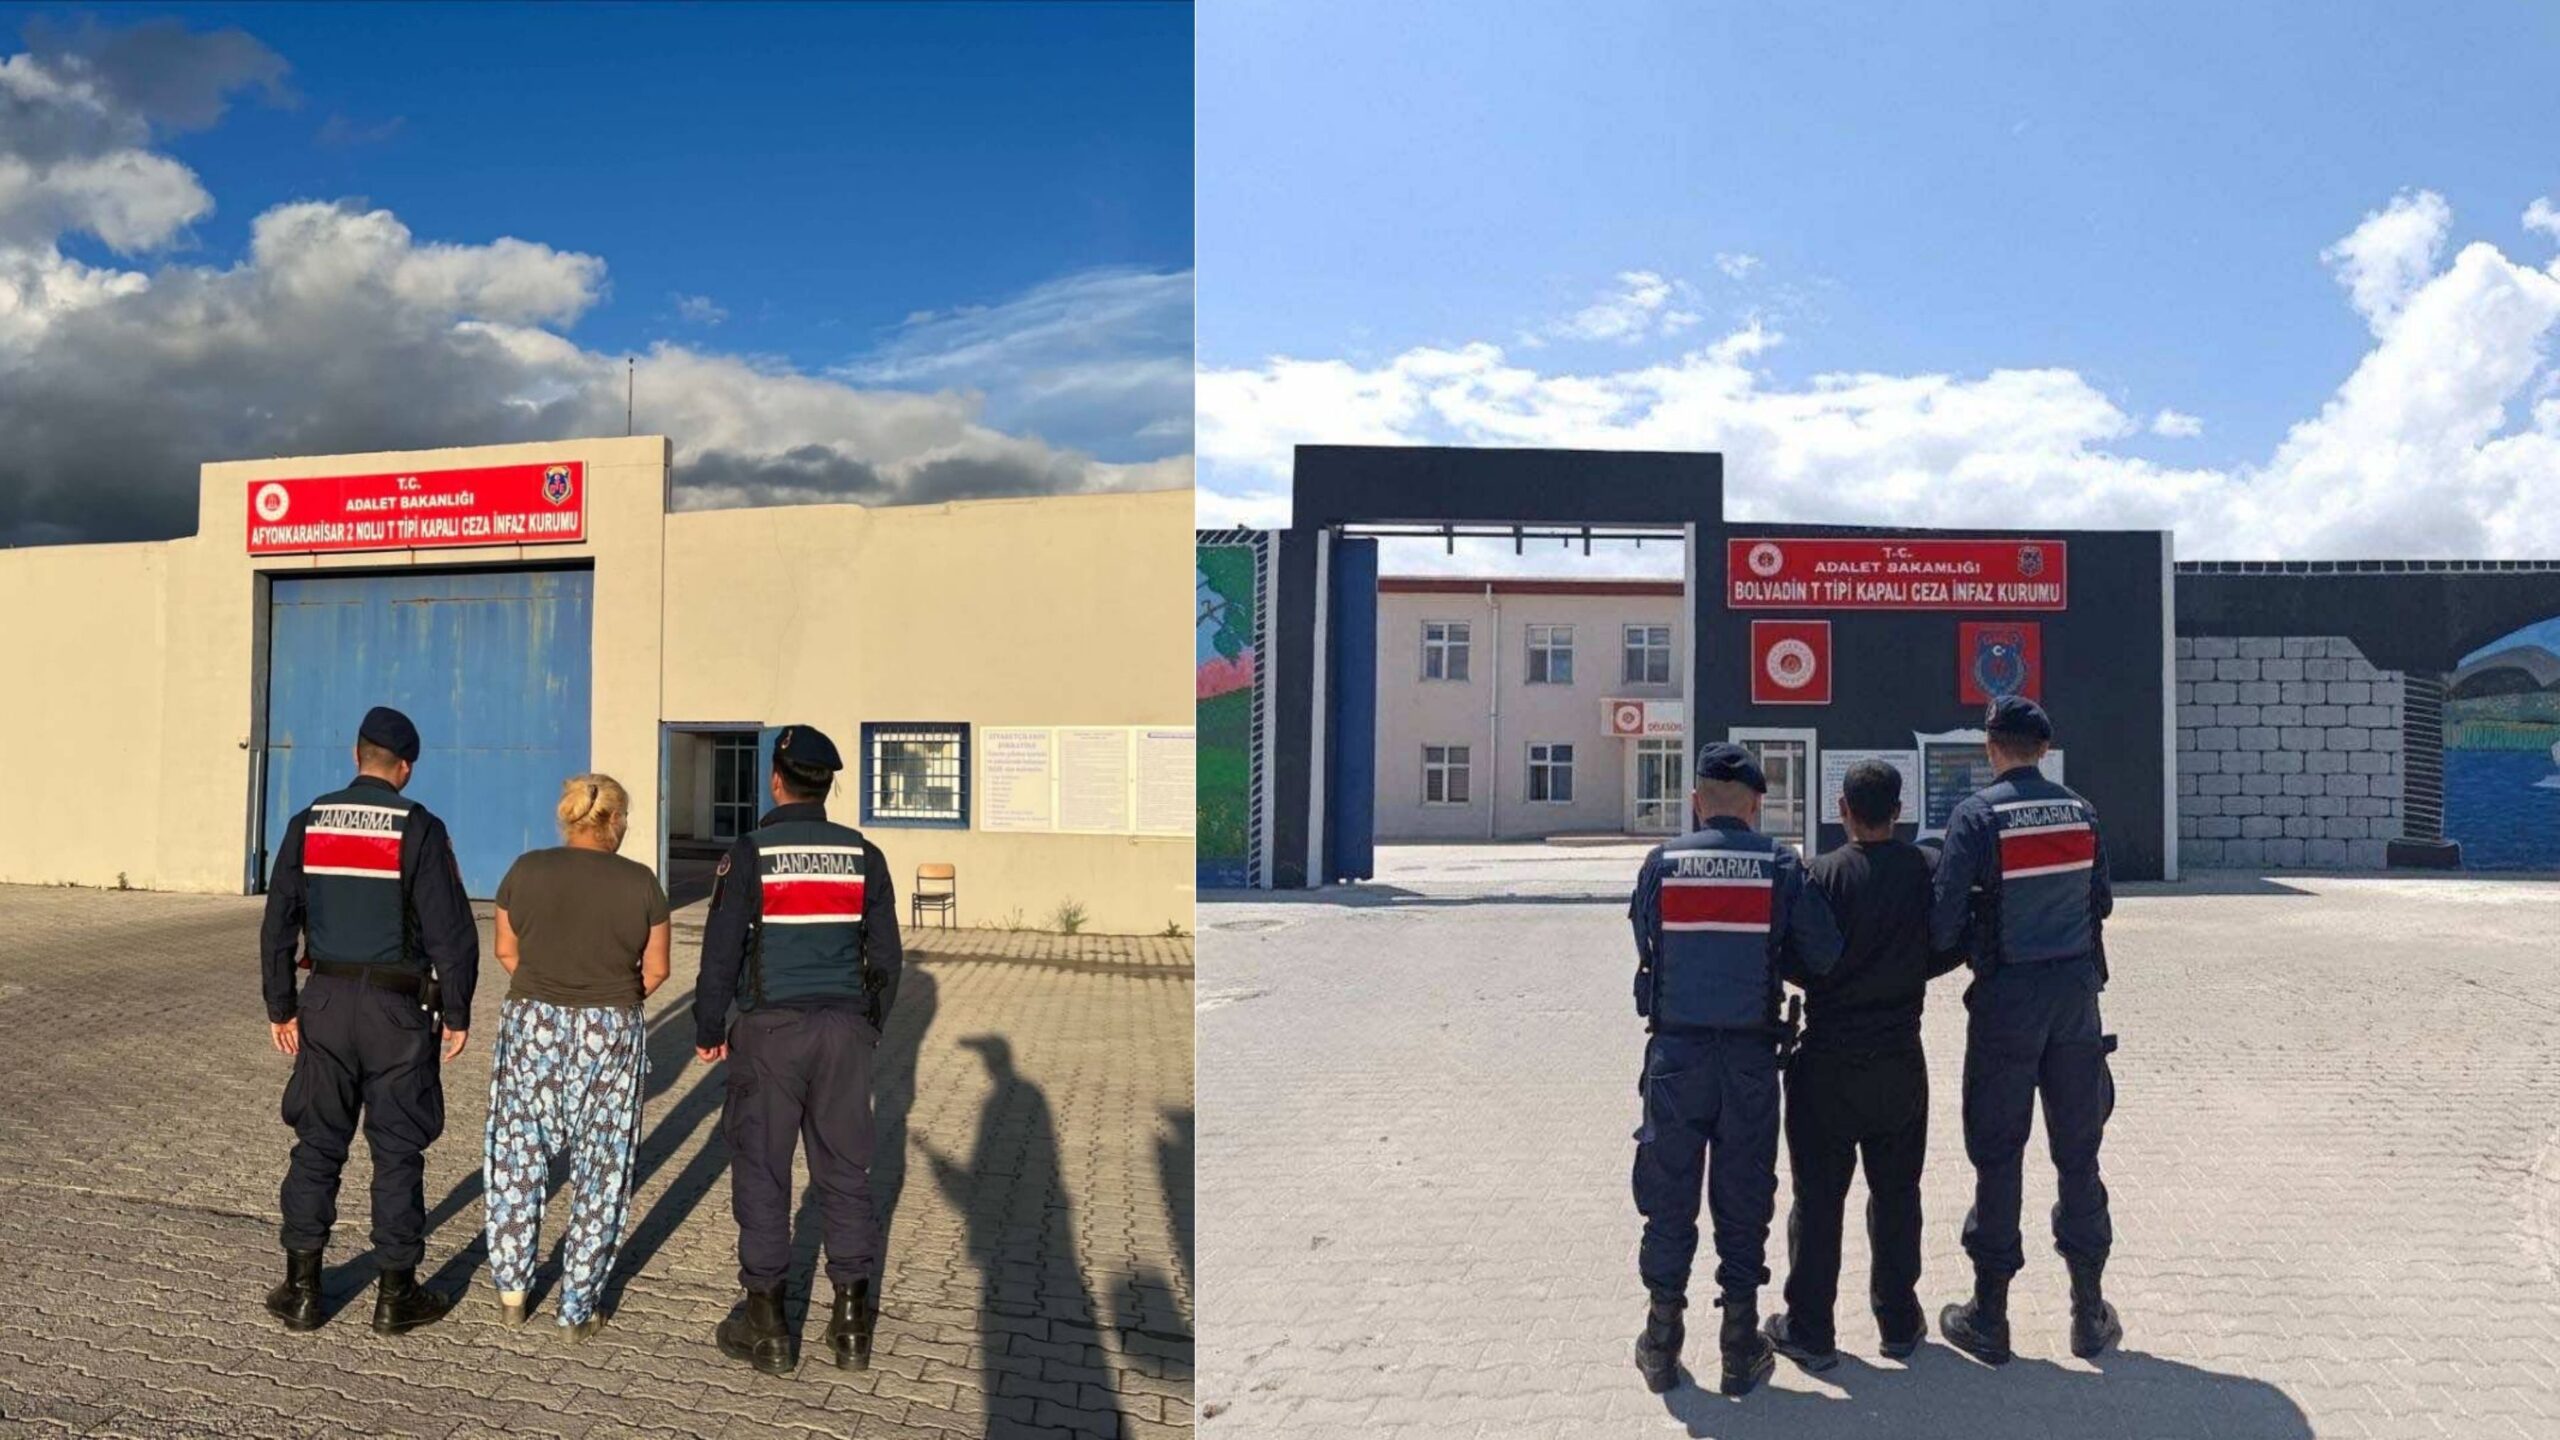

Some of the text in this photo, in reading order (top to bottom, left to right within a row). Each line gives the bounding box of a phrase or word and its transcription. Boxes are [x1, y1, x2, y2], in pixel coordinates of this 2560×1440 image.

[397, 477, 421, 490] T.C.
[346, 490, 474, 511] ADALET BAKANLIĞI
[251, 511, 578, 546] AFYONKARAHİSAR 2 NOLU T TİPİ KAPALI CEZA İNFAZ KURUMU
[1882, 547, 1913, 559] T.C.
[1814, 562, 1882, 573] ADALET
[1734, 577, 2060, 602] BOLVADİN T TİPİ KAPALI CEZA İNFAZ KURUMU
[315, 809, 393, 831] JANDARMA
[771, 853, 857, 874] JANDARMA
[1672, 858, 1763, 879] JANDARMA
